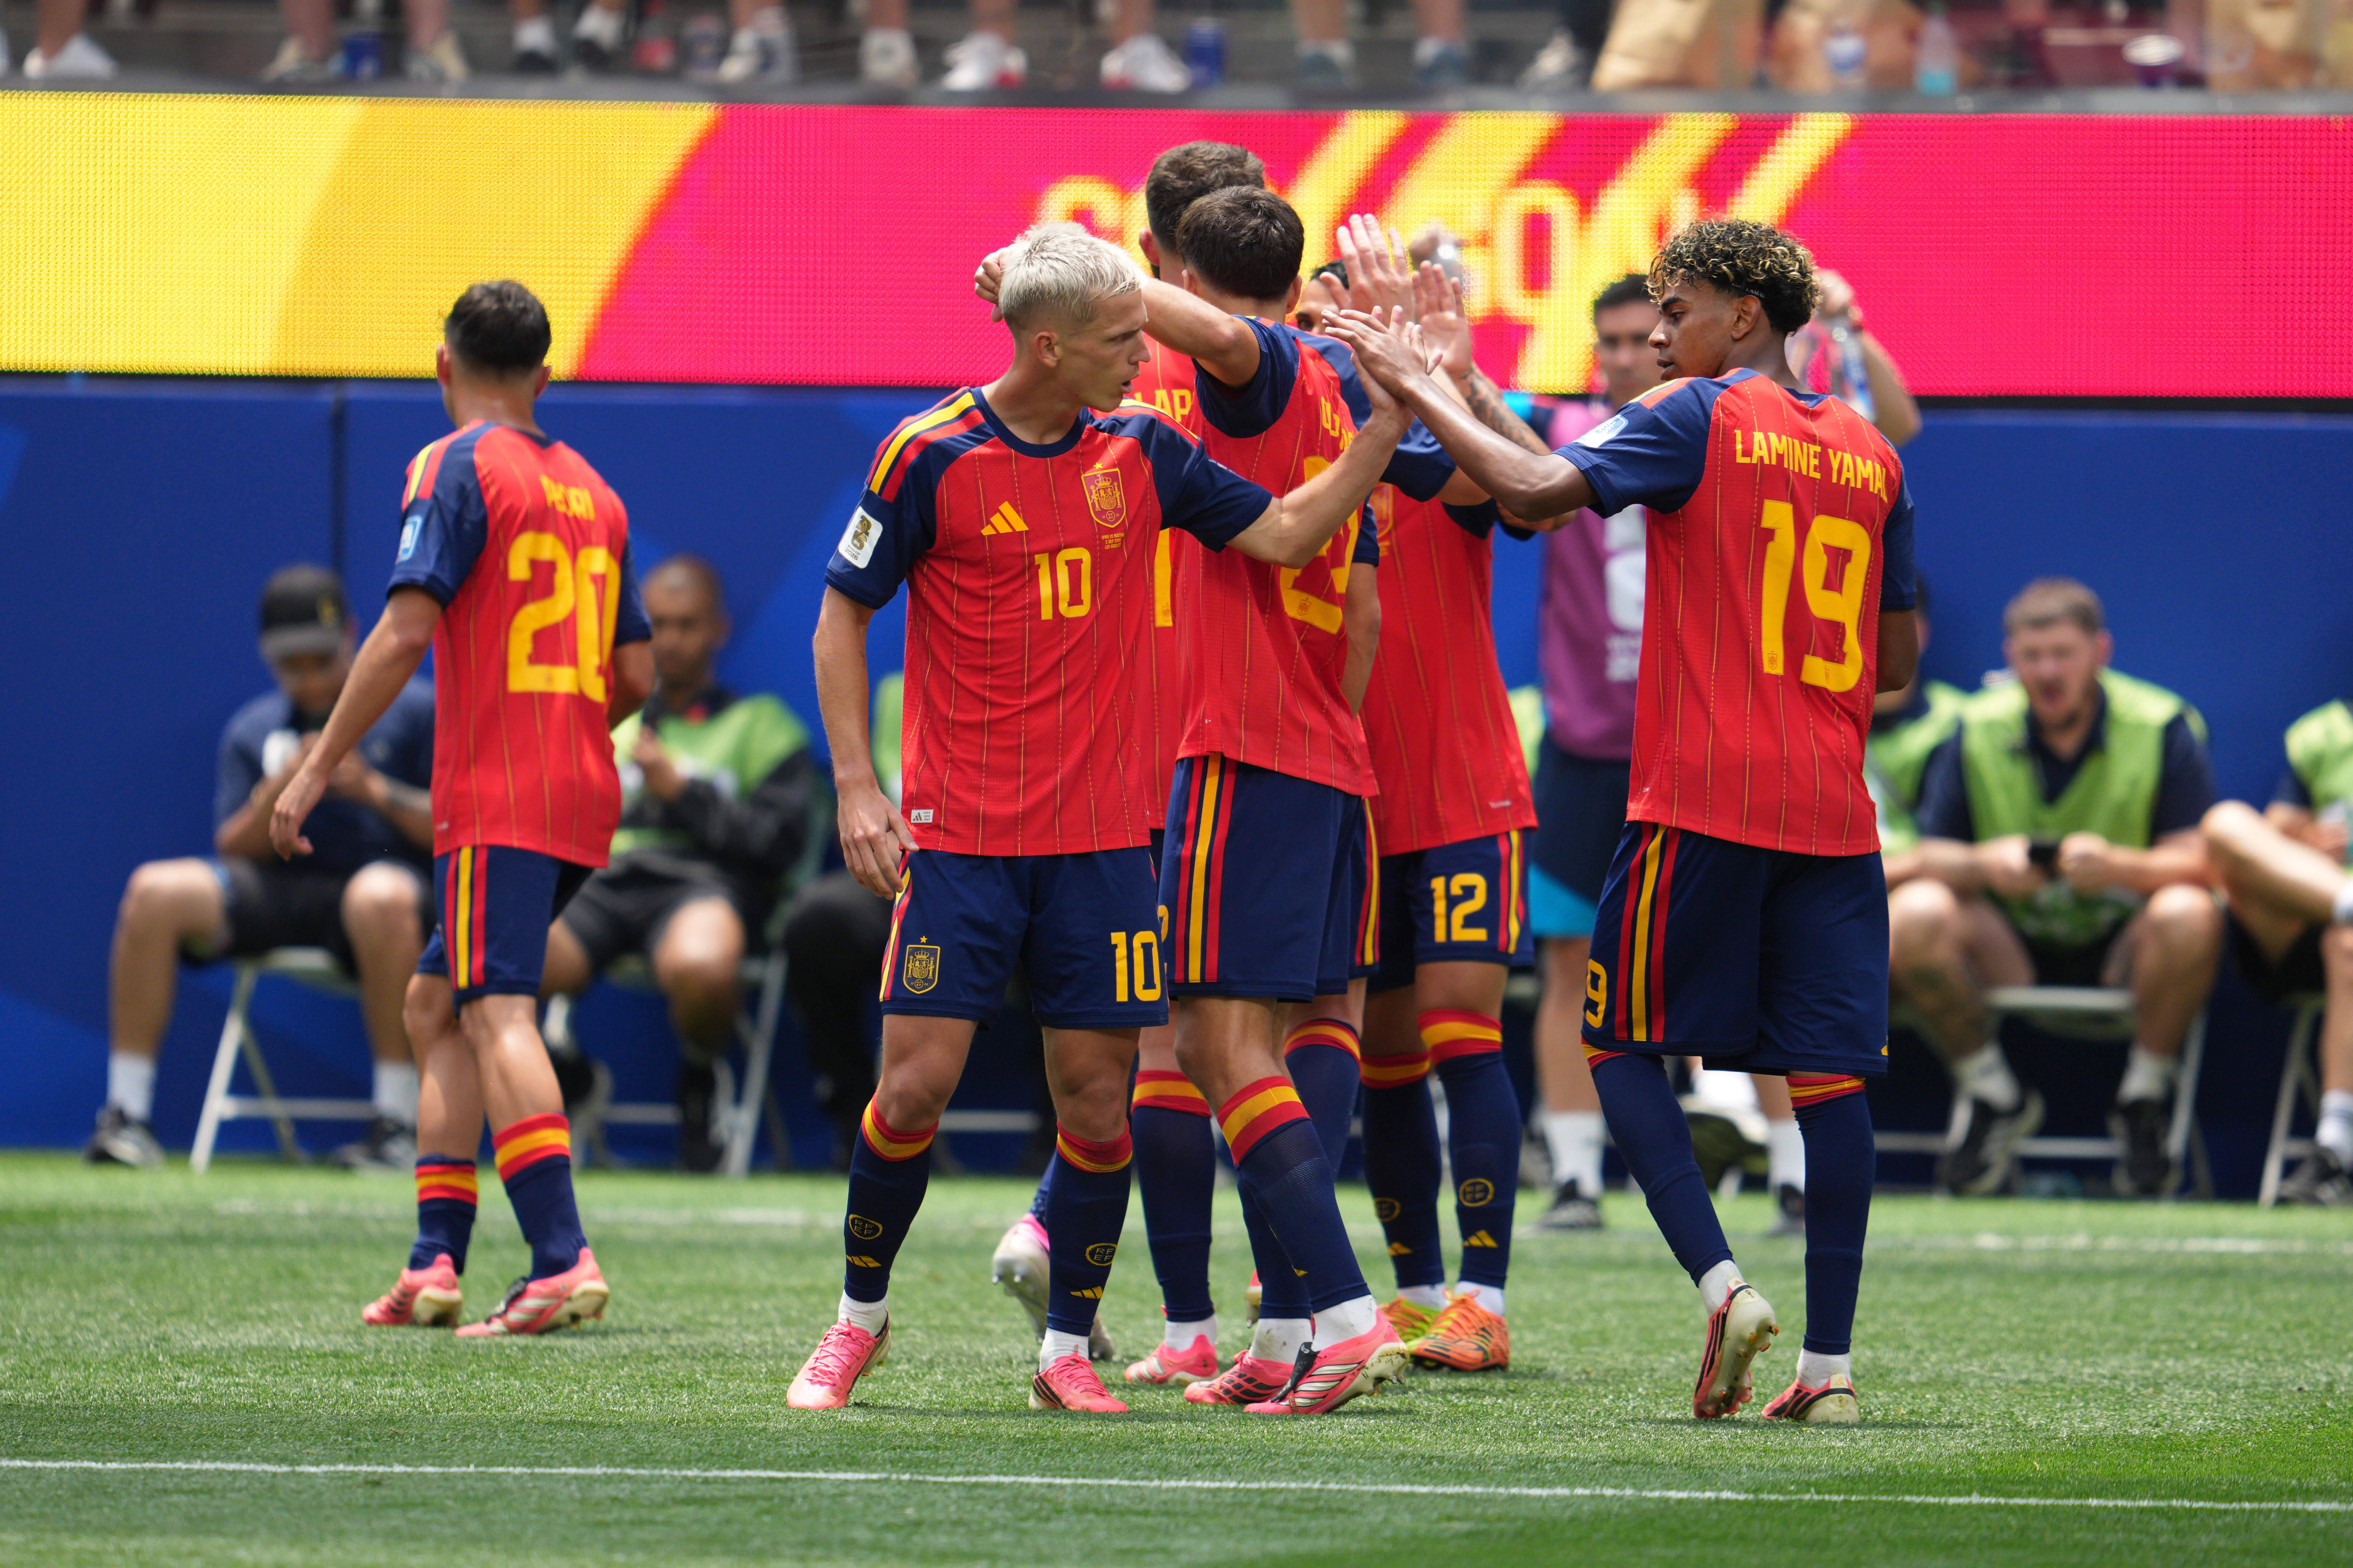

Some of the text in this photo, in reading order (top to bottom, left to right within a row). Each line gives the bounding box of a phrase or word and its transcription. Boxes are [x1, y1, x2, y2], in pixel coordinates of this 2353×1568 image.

[1734, 429, 1888, 504] LAMINE YAMAL
[845, 548, 858, 561] 2026
[1035, 547, 1091, 620] 10
[507, 531, 621, 703] 20
[1760, 499, 1872, 693] 19
[1431, 873, 1487, 943] 12
[1111, 930, 1161, 1002] 10
